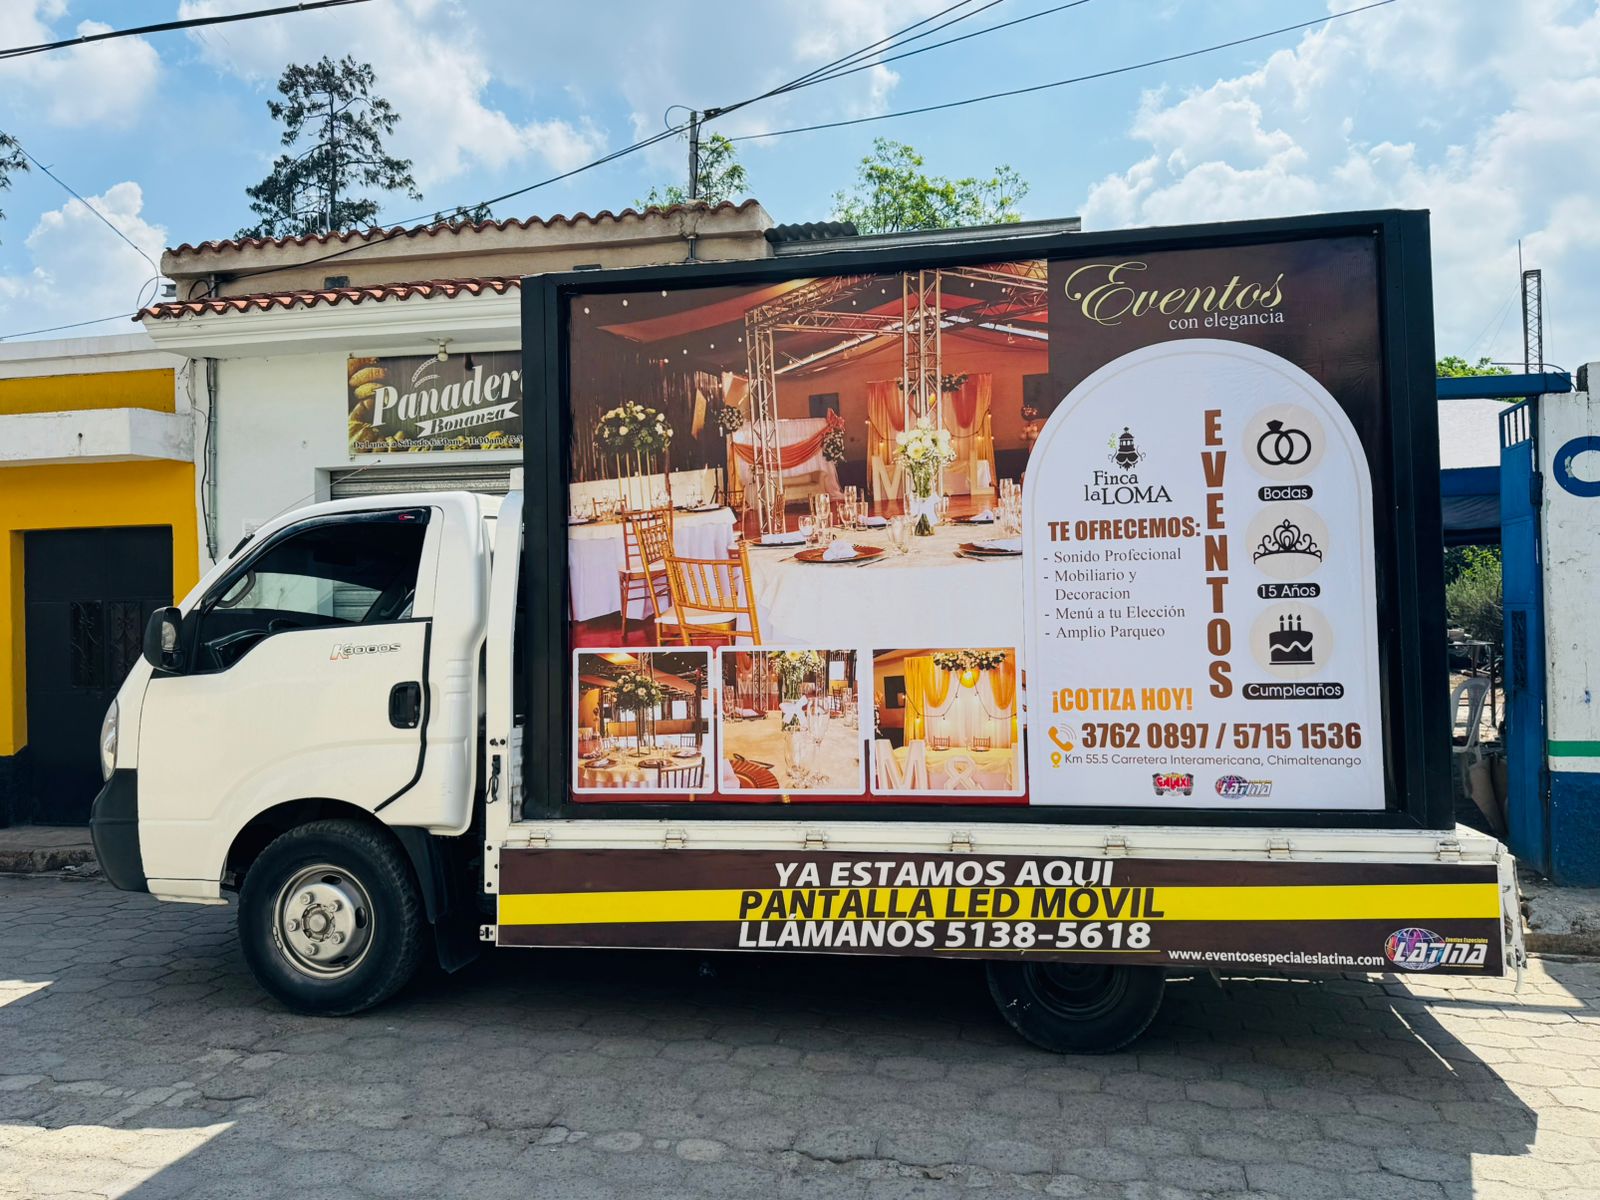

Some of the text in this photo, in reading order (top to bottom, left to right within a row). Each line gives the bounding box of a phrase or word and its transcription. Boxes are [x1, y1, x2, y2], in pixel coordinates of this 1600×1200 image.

[1064, 261, 1284, 326] Eventos
[1169, 309, 1284, 332] con elegancia
[371, 364, 522, 427] Panader
[431, 407, 505, 434] Bonanza
[1093, 470, 1138, 486] Finca
[1263, 487, 1308, 500] Bodas
[1048, 516, 1200, 541] TE OFRECEMOS:
[1054, 550, 1100, 563] Sonido
[1105, 548, 1181, 562] Profecional
[1055, 568, 1125, 582] Mobiliario
[1129, 571, 1137, 583] y
[1055, 587, 1131, 601] Decoracion
[1260, 584, 1316, 598] 15 Años
[1056, 606, 1093, 619] Menú
[1098, 610, 1105, 619] a
[1109, 608, 1122, 619] tu
[1126, 605, 1185, 619] Elección
[1056, 626, 1106, 641] Amplio
[1110, 624, 1165, 639] Parqueo
[1052, 688, 1192, 713] ¡COTIZA HOY!
[1248, 684, 1341, 699] Cumpleaños
[1082, 722, 1362, 749] 3762 0897 / 5715 1536
[1065, 754, 1362, 768] Km 55.5 Carretera Interamericana, Chimaltenango
[775, 860, 1114, 887] YA ESTAMOS AQUI
[739, 881, 1165, 919] PANTALLA LED MÓVIL
[738, 913, 1151, 949] LLÁMANOS 5138-5618
[1168, 948, 1385, 967] www.eventosespecialeslatina.com
